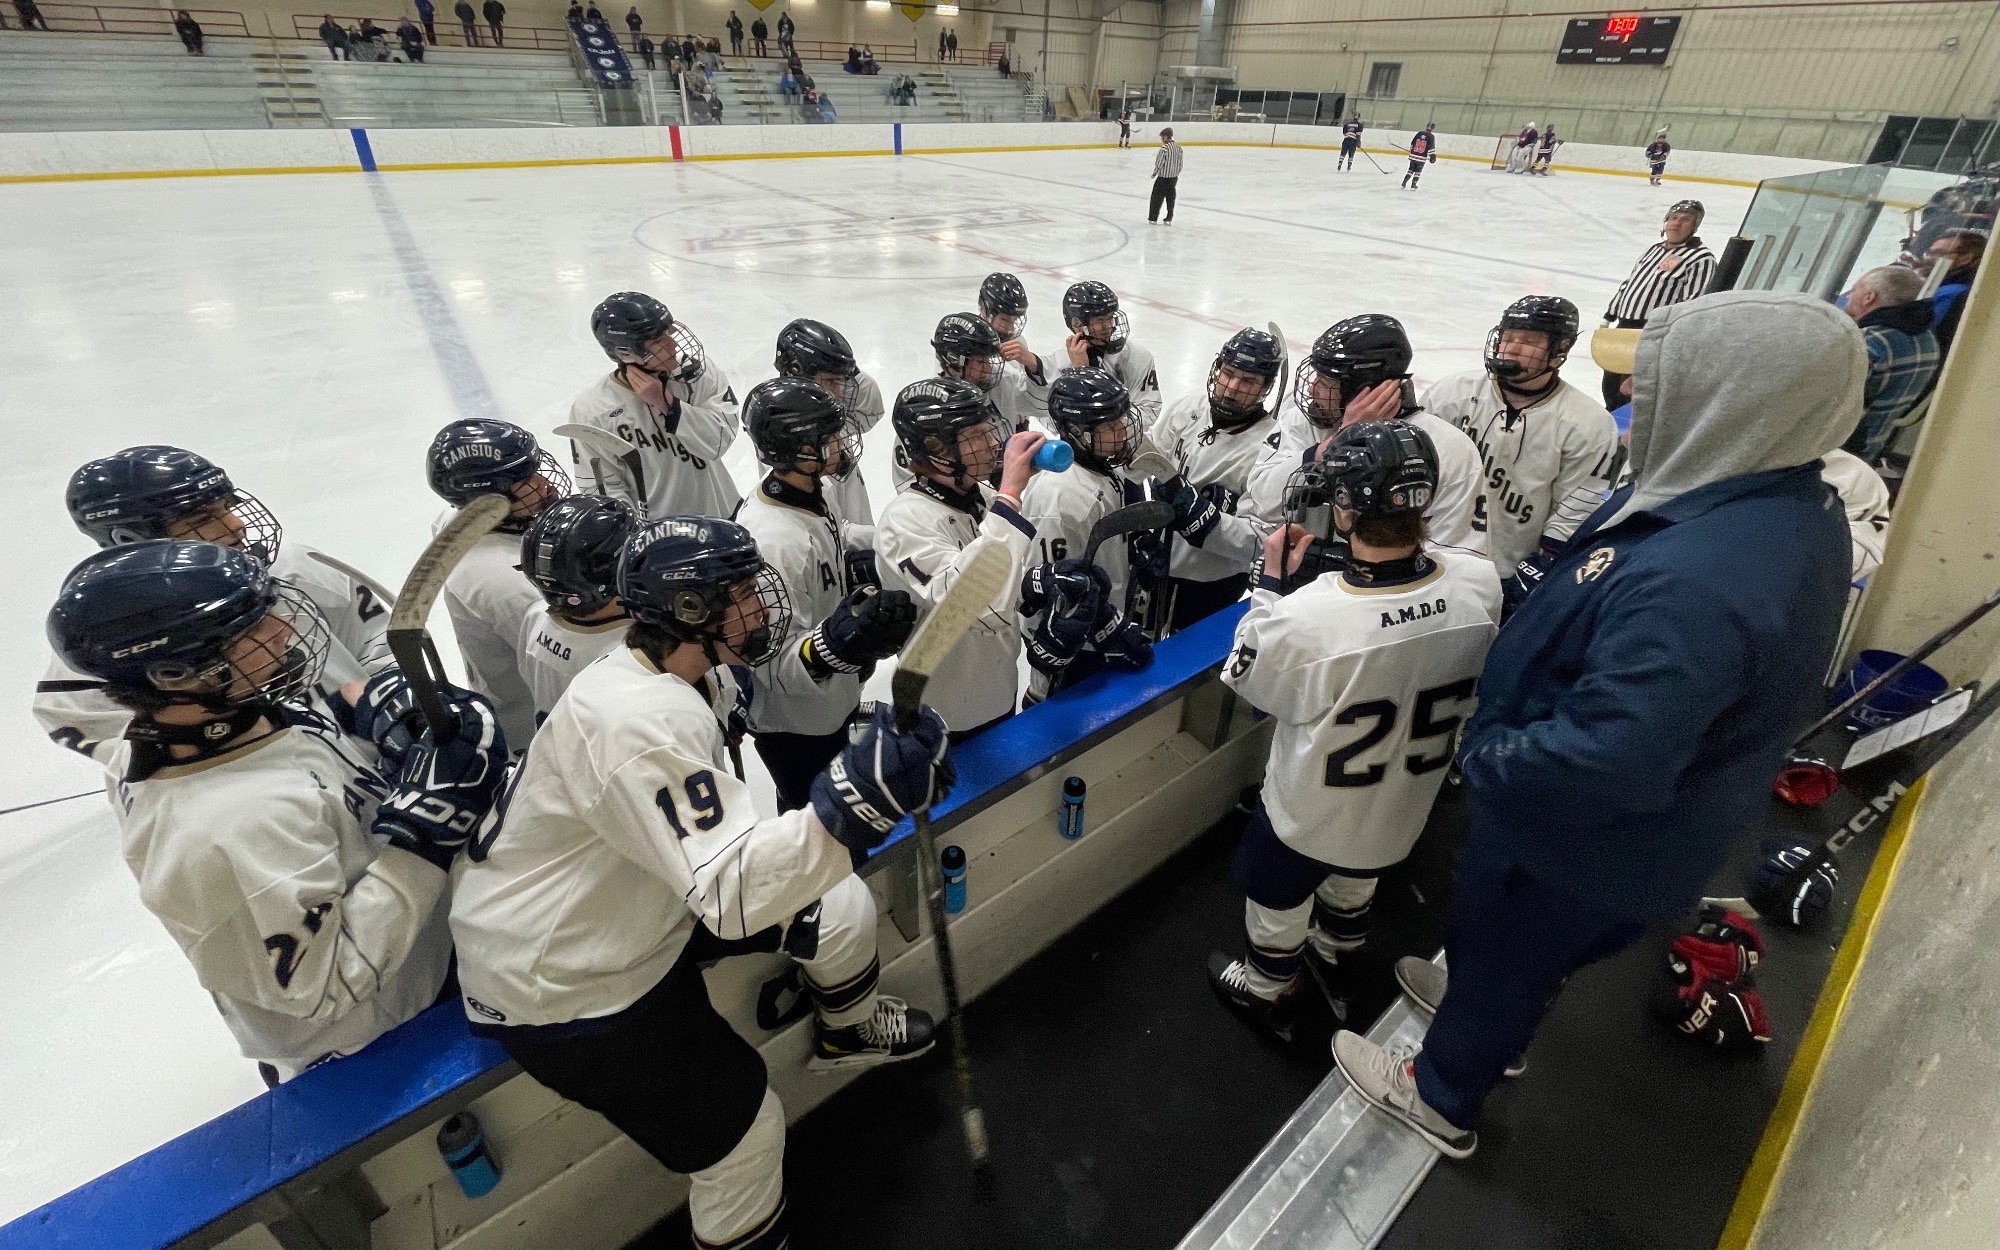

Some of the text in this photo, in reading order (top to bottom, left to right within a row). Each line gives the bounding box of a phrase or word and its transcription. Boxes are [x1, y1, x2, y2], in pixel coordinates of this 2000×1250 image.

[1606, 18, 1639, 32] 17:00
[902, 383, 950, 403] CANISIUS
[1141, 369, 1160, 392] 14
[443, 443, 502, 469] CANISIUS
[616, 424, 707, 470] CANISU
[197, 472, 225, 490] CCM
[1408, 487, 1431, 508] 18
[86, 508, 119, 520] CCM
[634, 521, 711, 553] CANISIUS
[1039, 537, 1068, 564] 16
[661, 567, 700, 581] CCM
[1031, 562, 1044, 595] BAU
[1517, 560, 1545, 582] BAU
[1094, 609, 1125, 643] BAU
[1380, 597, 1448, 629] A.M.D.G
[111, 636, 170, 659] CCM
[535, 630, 573, 662] A.M.D.G
[1323, 676, 1479, 789] 25
[655, 768, 725, 841] 19
[829, 748, 897, 834] BAUE
[377, 787, 478, 834] CCM
[1825, 779, 1908, 853] CCM
[1677, 990, 1718, 1034] UER
